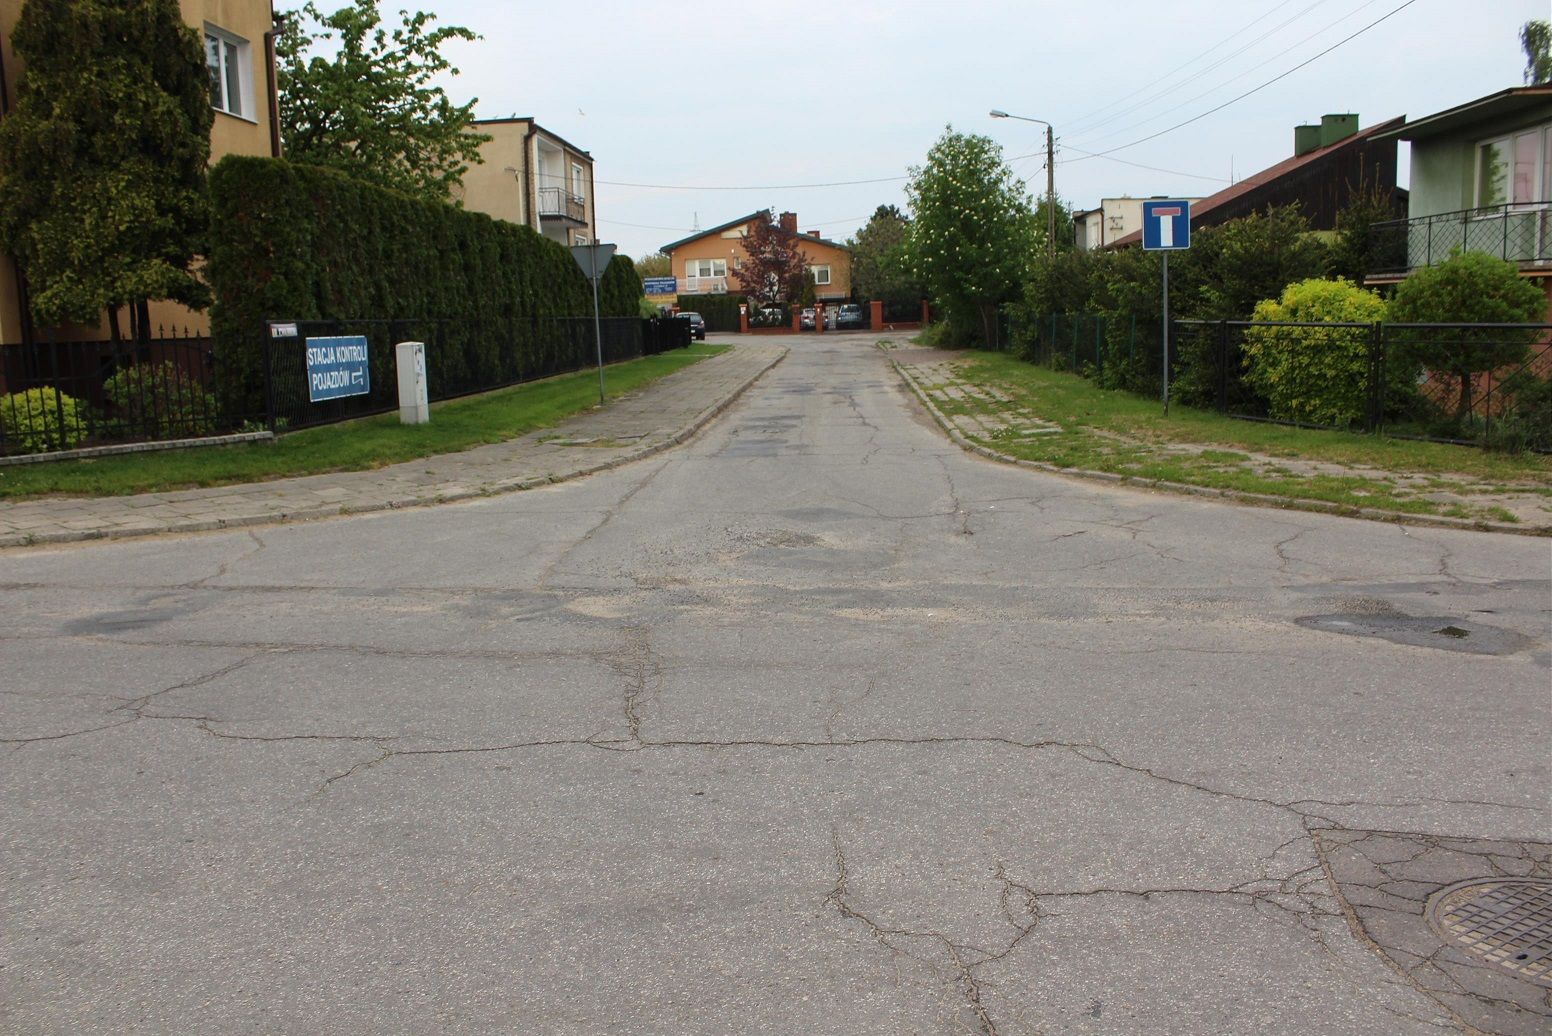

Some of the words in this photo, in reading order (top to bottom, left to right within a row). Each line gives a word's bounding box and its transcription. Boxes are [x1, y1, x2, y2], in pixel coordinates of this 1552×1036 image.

[308, 347, 335, 365] STACJA
[336, 345, 367, 362] KONTROLI
[312, 367, 350, 391] POJAZDÓW
